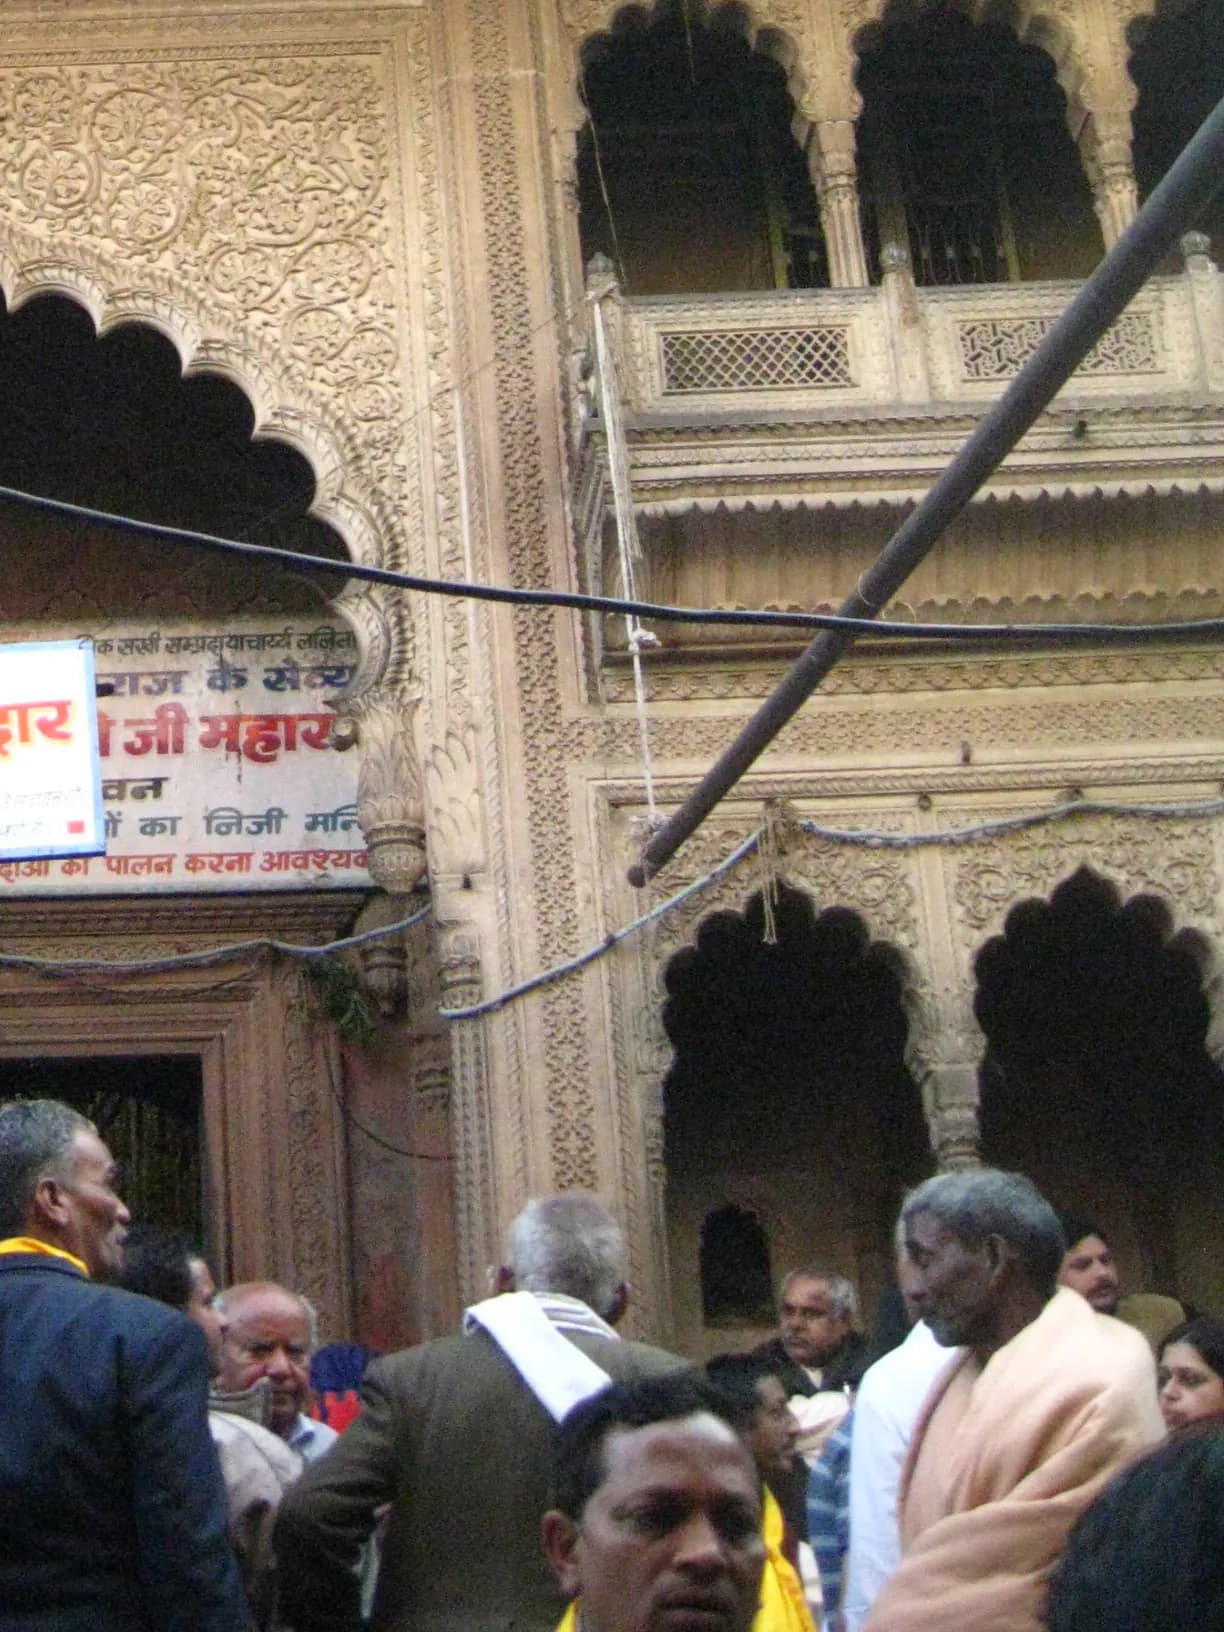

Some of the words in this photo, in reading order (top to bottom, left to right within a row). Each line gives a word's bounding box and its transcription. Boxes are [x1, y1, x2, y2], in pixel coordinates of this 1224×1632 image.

[207, 660, 248, 692] के
[123, 702, 190, 756] जी
[199, 713, 342, 763] महार
[139, 817, 183, 837] का
[203, 807, 289, 836] निजी
[104, 854, 177, 876] पालन
[184, 851, 256, 874] करना
